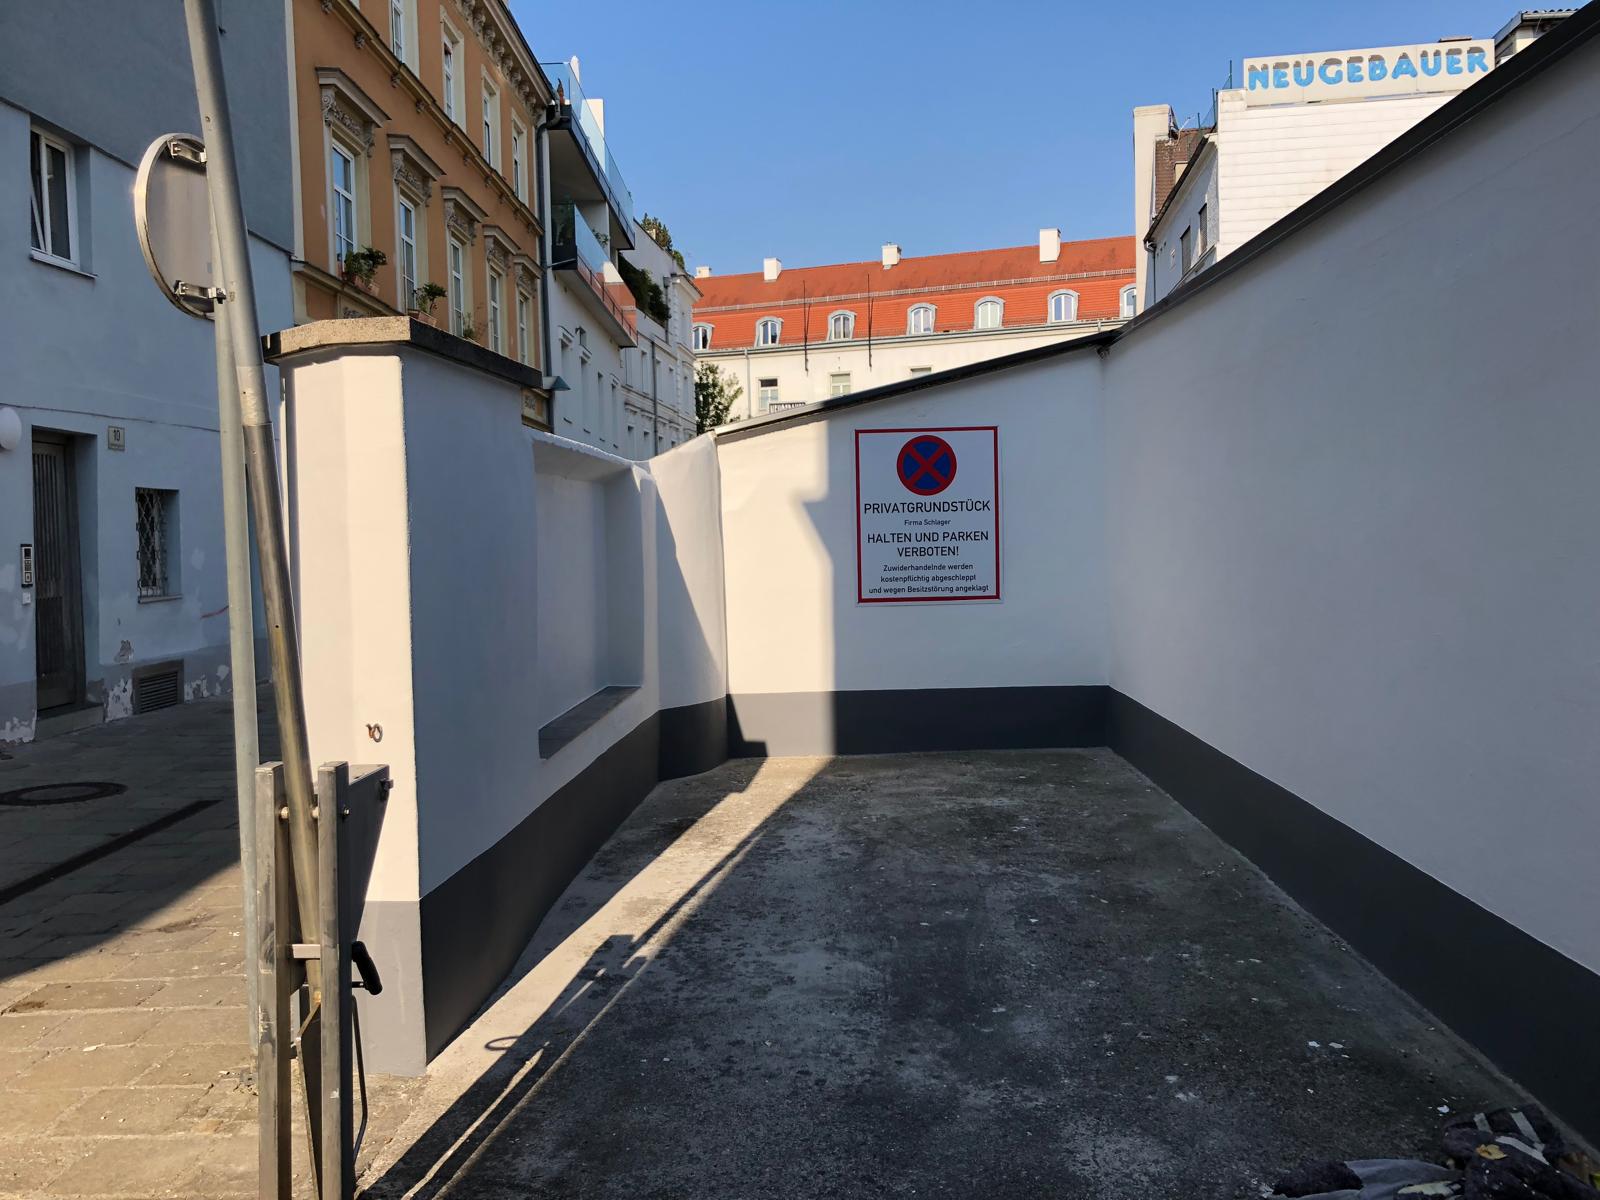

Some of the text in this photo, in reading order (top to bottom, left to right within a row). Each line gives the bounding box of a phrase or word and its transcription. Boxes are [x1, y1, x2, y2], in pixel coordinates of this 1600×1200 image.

[1248, 46, 1489, 91] NEUGEBAUER
[864, 499, 991, 514] PRIVATGRUNDSTÜCK
[867, 531, 989, 543] HALTEN UND PARKEN
[897, 546, 960, 557] VERBOTEN!
[883, 564, 946, 572] Zuwiderhandelnde
[880, 574, 976, 583] kostenpflichtig abgeschleppt
[907, 585, 954, 593] Besitzstörung
[955, 584, 989, 592] angeklagt
